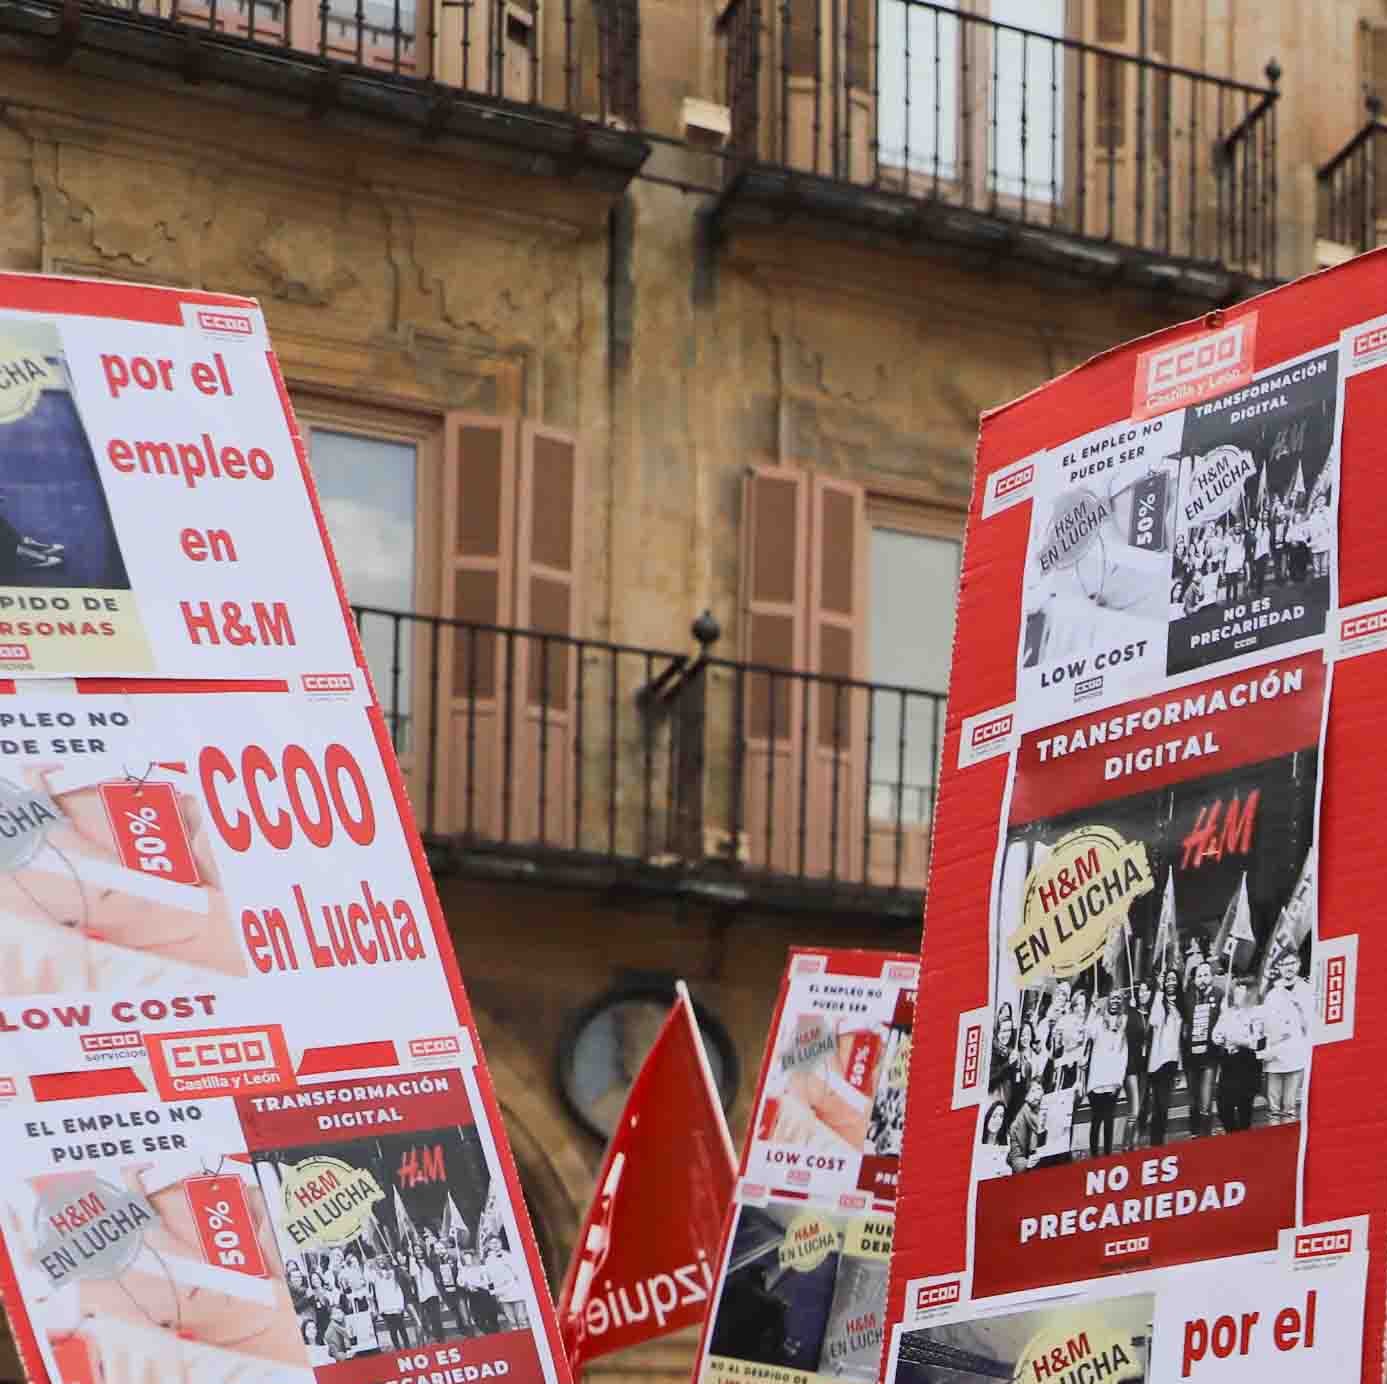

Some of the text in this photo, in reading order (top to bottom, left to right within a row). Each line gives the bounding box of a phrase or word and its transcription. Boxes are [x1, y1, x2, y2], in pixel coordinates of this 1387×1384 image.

[100, 352, 233, 397] por el
[1195, 359, 1328, 418] TRANSFORMACIÓN
[1230, 396, 1288, 425] DIGITAL
[107, 433, 274, 488] empleo
[1062, 420, 1164, 467] EL EMPLEO NO
[1069, 446, 1145, 482] PUEDE SER
[1184, 459, 1252, 521] EN LUCHA
[1198, 455, 1230, 490] H&M
[1039, 504, 1108, 572] EN LUCHA
[1054, 500, 1089, 538] H&M
[1136, 492, 1157, 547] 50%
[180, 527, 237, 563] en
[83, 597, 119, 612] DE
[180, 601, 296, 646] H&M
[1190, 605, 1305, 649] PRECARIEDAD
[1223, 597, 1272, 622] NO ES
[1040, 640, 1148, 689] LOW COST
[88, 711, 129, 727] NO
[1036, 667, 1303, 763] TRANSFORMACIÓN
[51, 738, 106, 754] SER
[1104, 731, 1220, 781] DIGITAL
[199, 744, 375, 852] CCOO
[125, 807, 172, 873] 50%
[1181, 788, 1261, 870] H&M
[1038, 847, 1102, 913] H&M
[241, 880, 426, 973] en Lucha
[1013, 857, 1144, 976] EN LUCHA
[111, 994, 217, 1024] COST
[85, 1048, 146, 1061] servicios
[173, 1039, 266, 1068] CCOO
[174, 1073, 230, 1092] Castilla
[242, 1070, 281, 1086] León
[251, 1075, 449, 1113] TRANSFORMACIÓN
[25, 1105, 202, 1138] EL EMPLEO NO
[318, 1107, 404, 1130] DIGITAL
[51, 1134, 188, 1163] PUEDE SER
[766, 1150, 848, 1173] LOW COST
[294, 1169, 341, 1209] H&M
[1086, 1155, 1179, 1197] NO ES
[50, 1190, 108, 1238] H&M
[287, 1176, 376, 1244] EN LUCHA
[1020, 1181, 1246, 1244] PRECARIEDAD
[40, 1201, 152, 1281] EN LUCHA
[204, 1201, 245, 1266] 50%
[1104, 1236, 1150, 1257] CCOO
[1182, 1290, 1317, 1377] por el
[397, 1347, 462, 1373] NO ES
[1032, 1331, 1092, 1383] H&M
